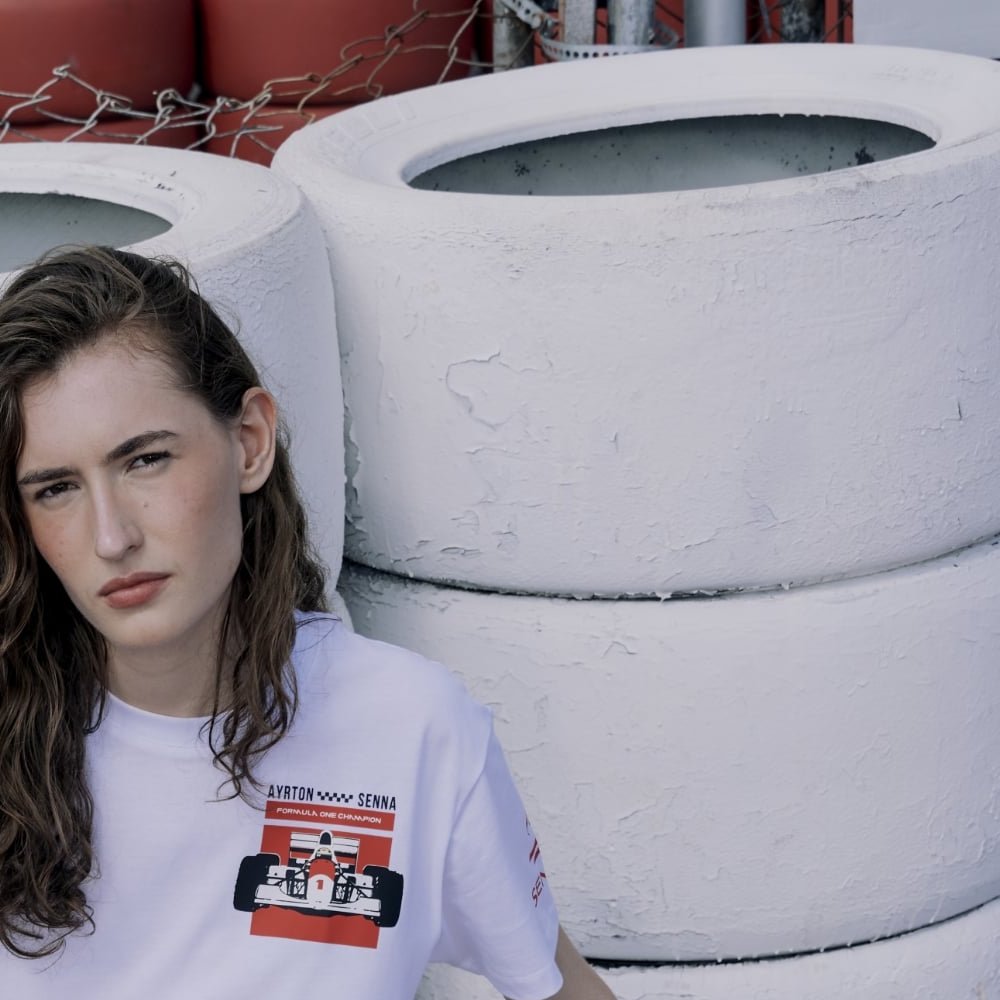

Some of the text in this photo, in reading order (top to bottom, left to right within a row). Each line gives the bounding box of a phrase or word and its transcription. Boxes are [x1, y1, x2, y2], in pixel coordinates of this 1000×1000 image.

[267, 784, 397, 811] AYRTON SENNA
[276, 807, 382, 824] FORMULA ONE CHAMPION
[316, 879, 324, 890] 1
